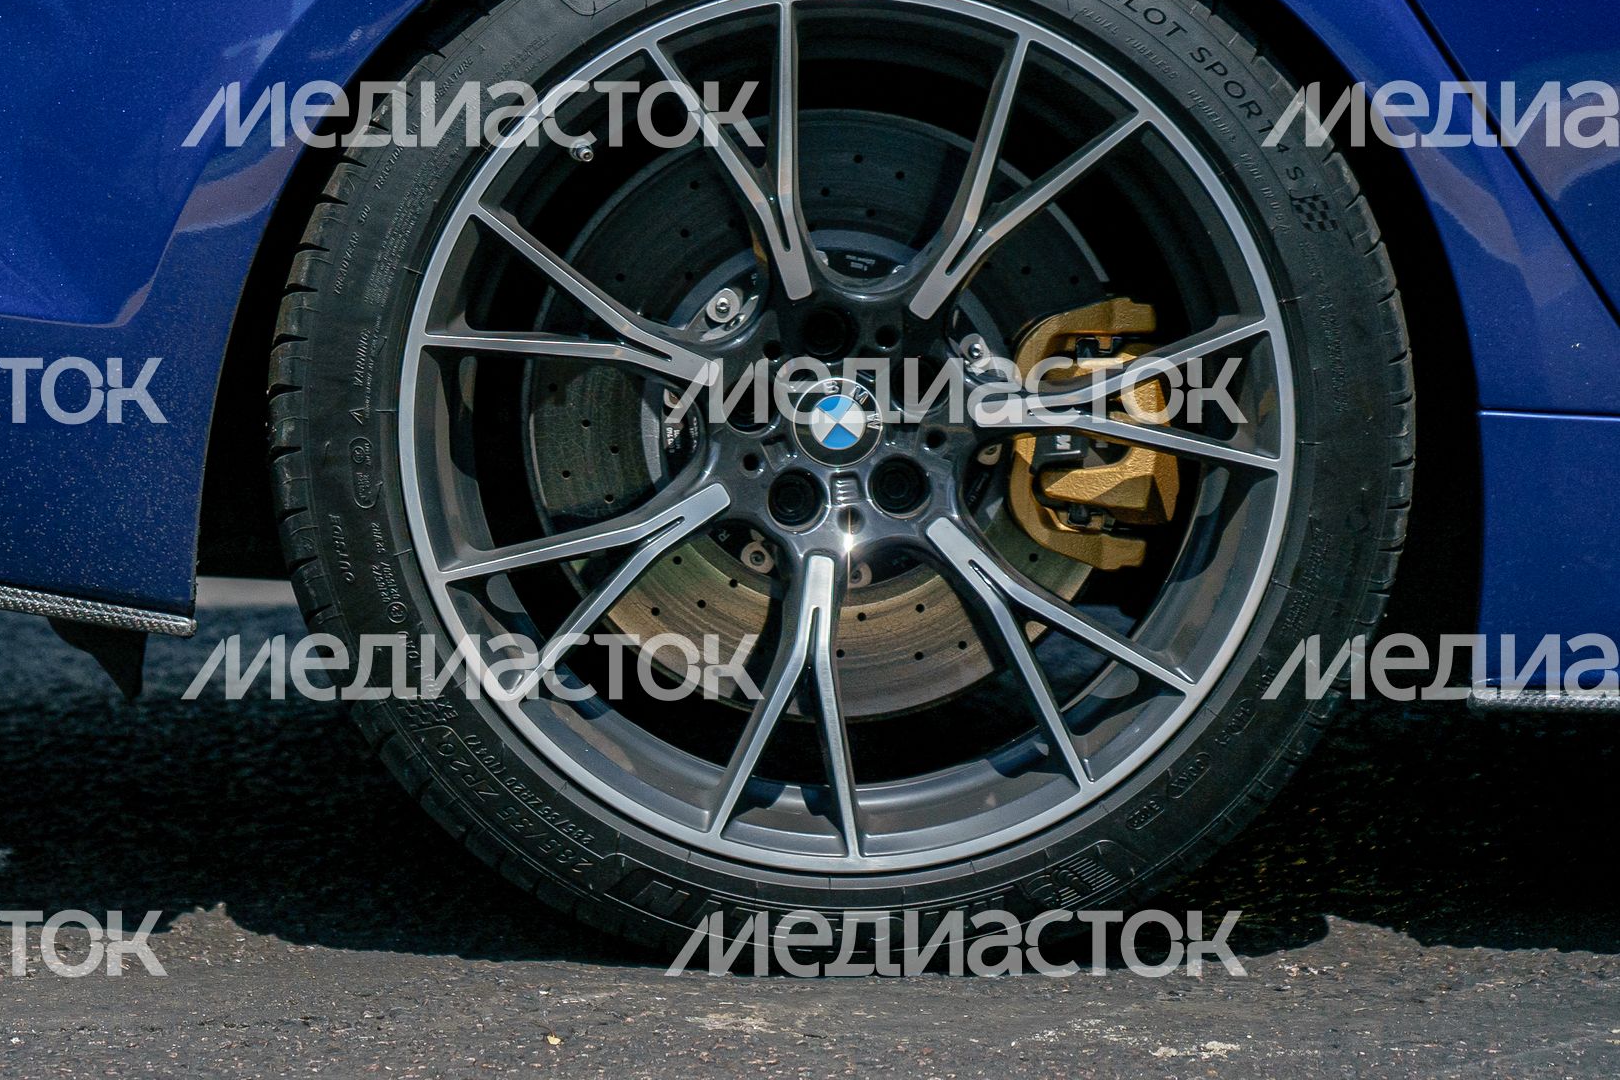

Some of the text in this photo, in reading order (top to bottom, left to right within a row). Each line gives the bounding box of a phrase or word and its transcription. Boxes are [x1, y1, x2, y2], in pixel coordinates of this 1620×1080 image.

[1188, 41, 1279, 143] SPORT
[1271, 136, 1290, 156] 4
[1283, 161, 1306, 184] S
[823, 380, 883, 431] BMW
[434, 736, 593, 878] 285/35 ZR20
[537, 801, 595, 848] 285/35
